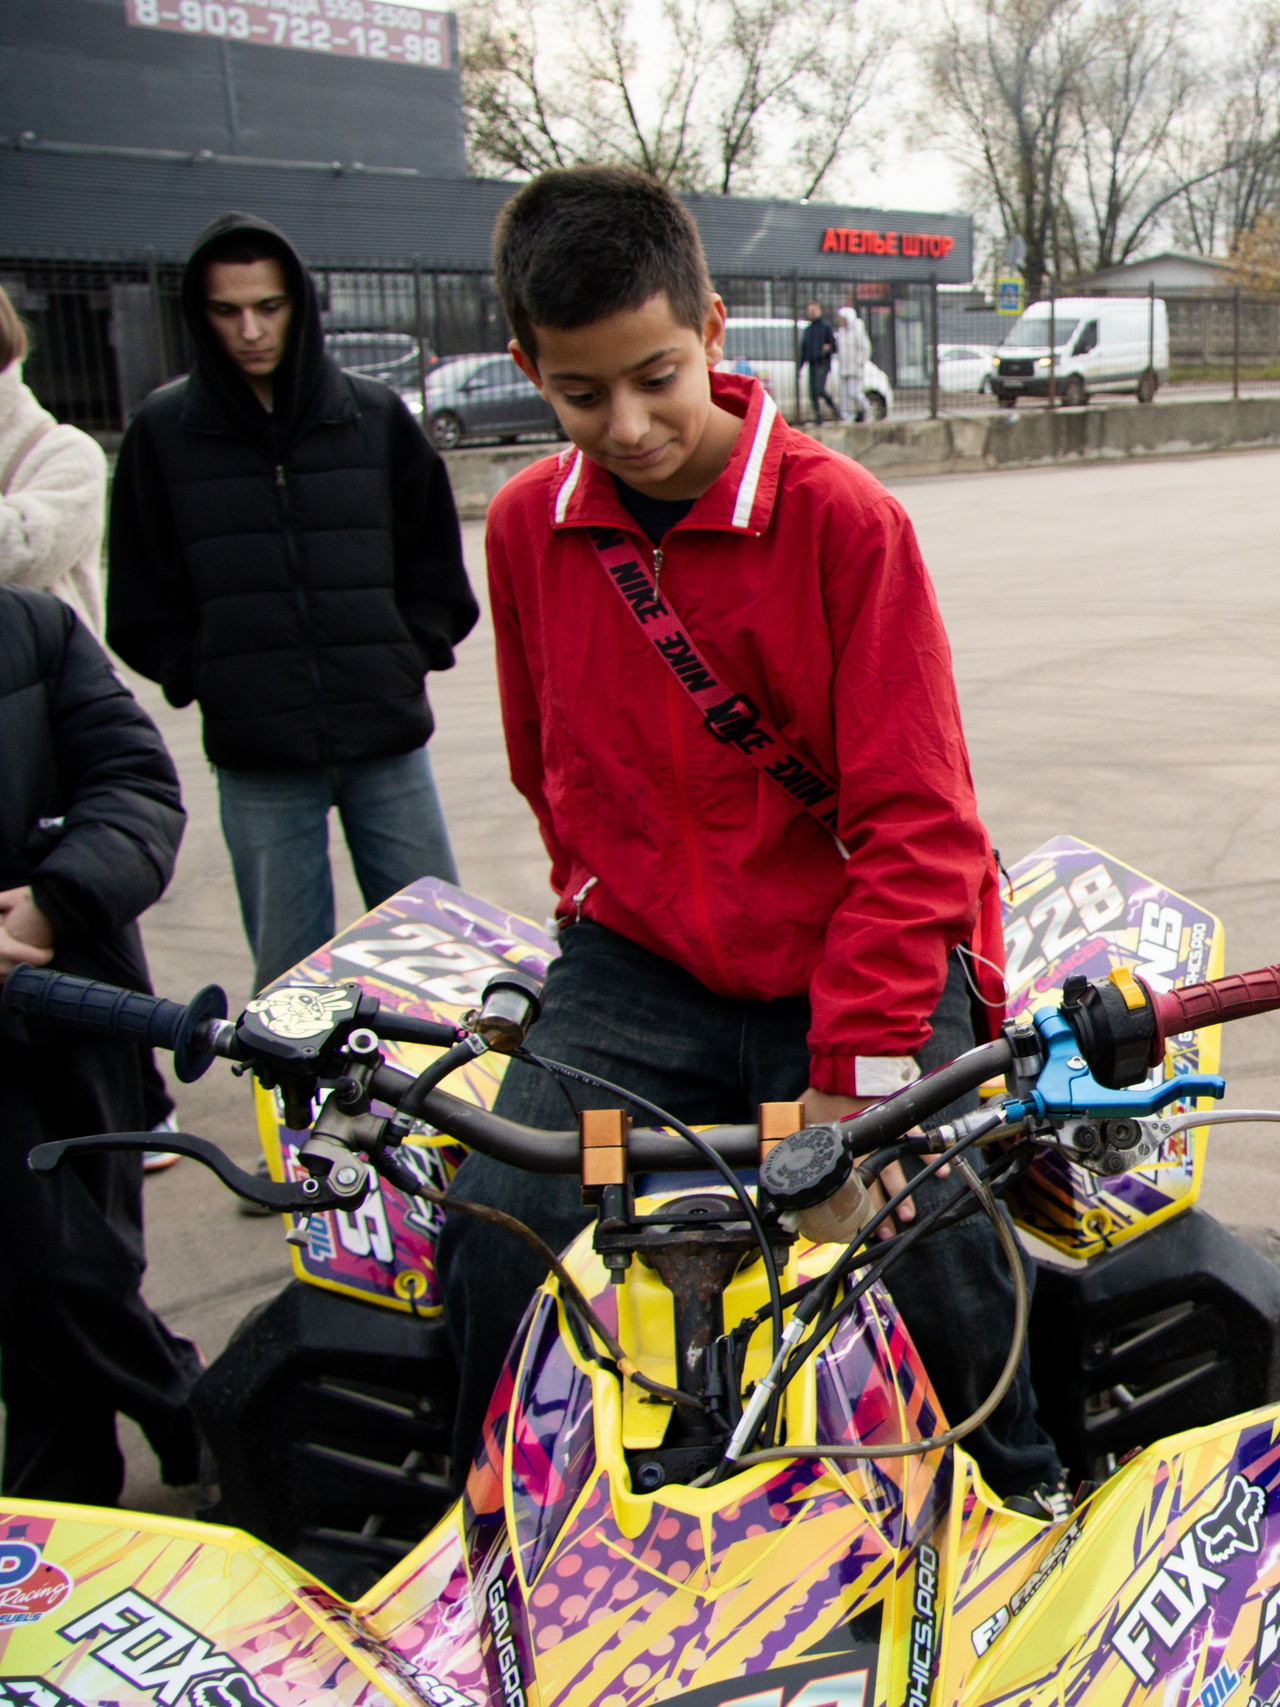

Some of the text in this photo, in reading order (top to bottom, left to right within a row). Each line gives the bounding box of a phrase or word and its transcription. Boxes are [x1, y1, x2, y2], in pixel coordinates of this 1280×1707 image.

[134, 0, 443, 66] 8-903-722-12-98
[323, 0, 422, 31] 550-2500
[822, 227, 955, 258] АТЕЛЬЕ ШТОР
[609, 560, 669, 624] NIKE
[654, 630, 717, 693] NIKE
[763, 753, 835, 808] NIKE
[1003, 862, 1125, 996] 228
[1035, 937, 1109, 993] CANCER
[1110, 1531, 1228, 1687] FOX
[57, 1587, 239, 1707] FOX
[1193, 1662, 1240, 1707] OIL
